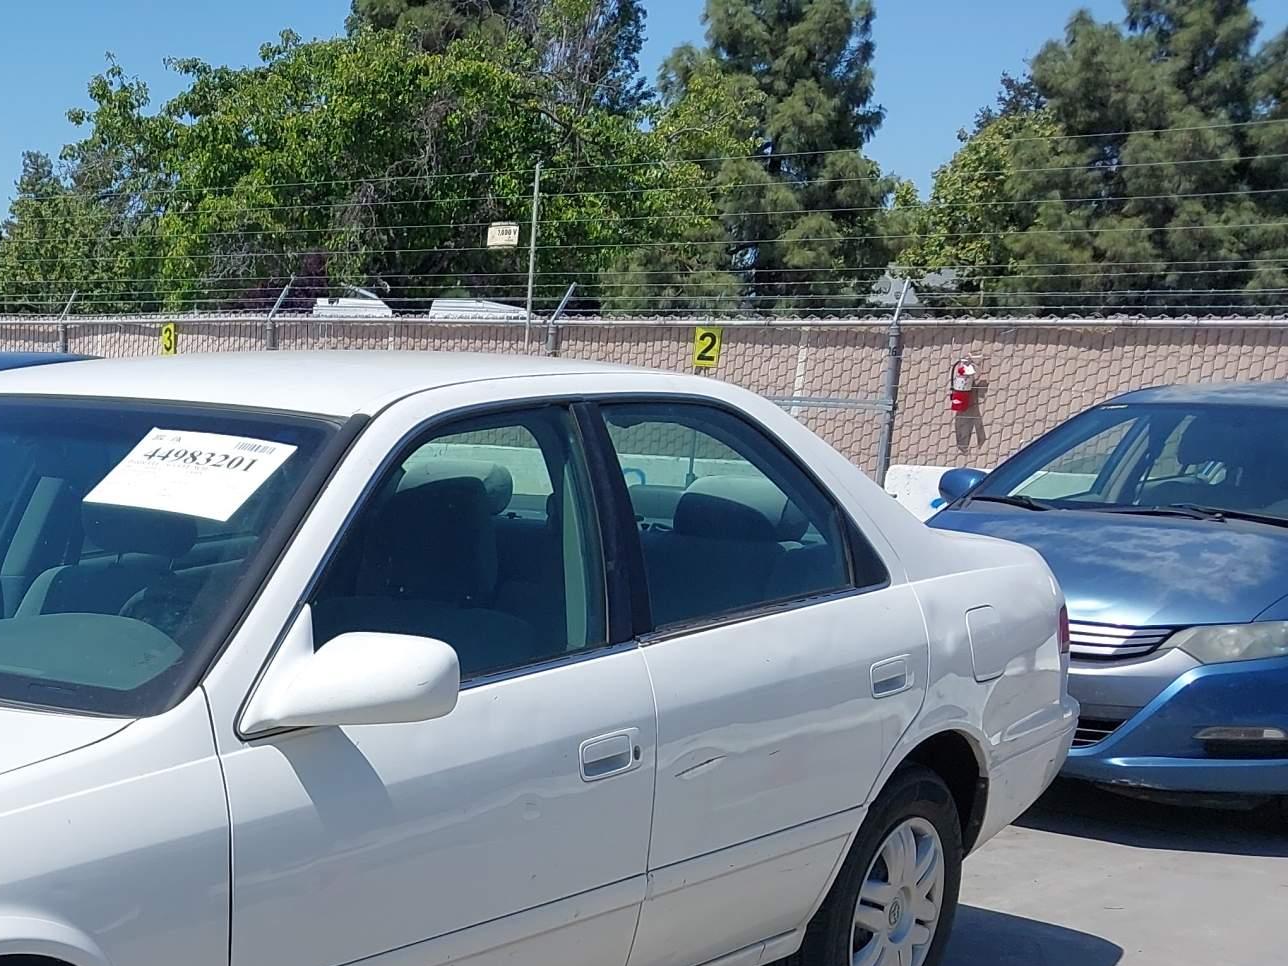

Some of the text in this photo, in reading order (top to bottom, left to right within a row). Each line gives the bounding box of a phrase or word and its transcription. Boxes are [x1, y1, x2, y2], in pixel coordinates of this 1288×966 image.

[163, 327, 172, 352] 3
[697, 332, 717, 361] 2
[143, 447, 259, 472] 44983201
